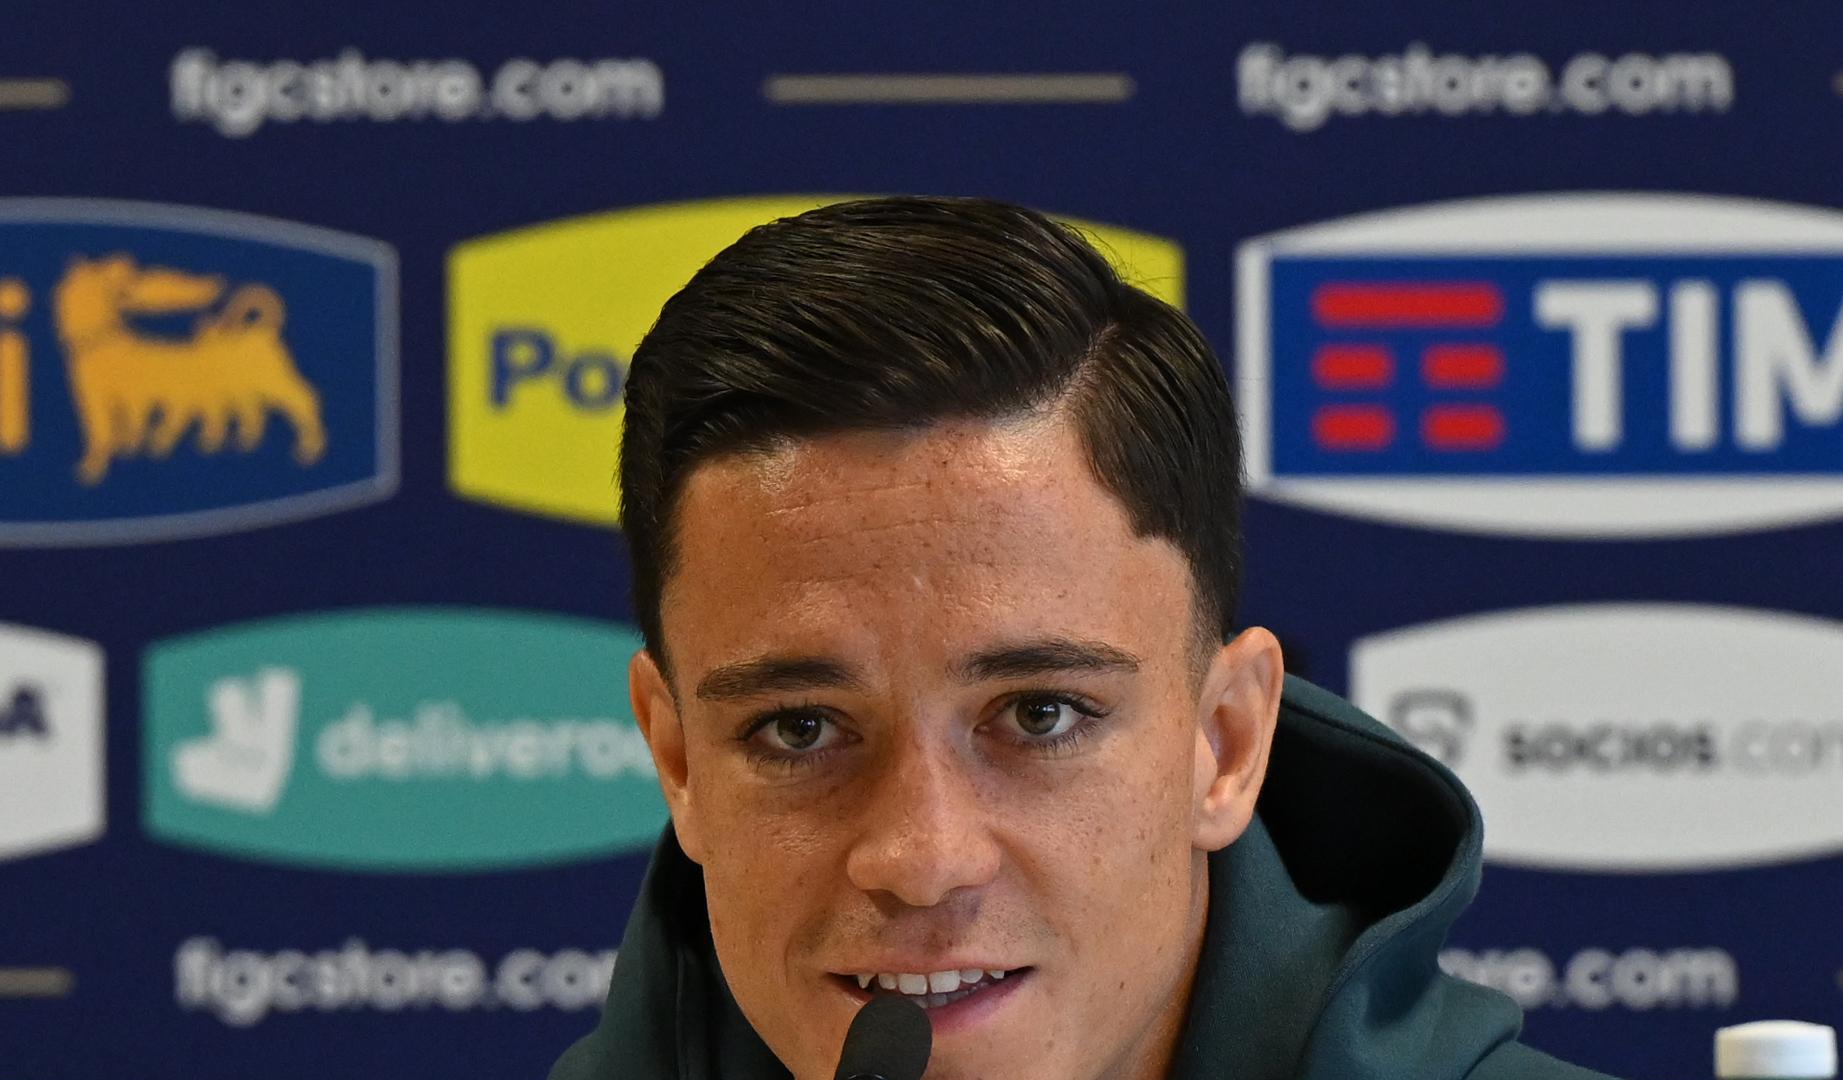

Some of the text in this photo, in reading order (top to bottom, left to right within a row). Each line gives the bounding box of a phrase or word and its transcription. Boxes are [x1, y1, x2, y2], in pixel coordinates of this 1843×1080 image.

[172, 50, 662, 135] figcstore.com
[1238, 44, 1732, 129] figcstore.com
[487, 326, 628, 413] Po
[1534, 281, 1843, 450] TIM
[177, 939, 618, 1024] figcstore.co
